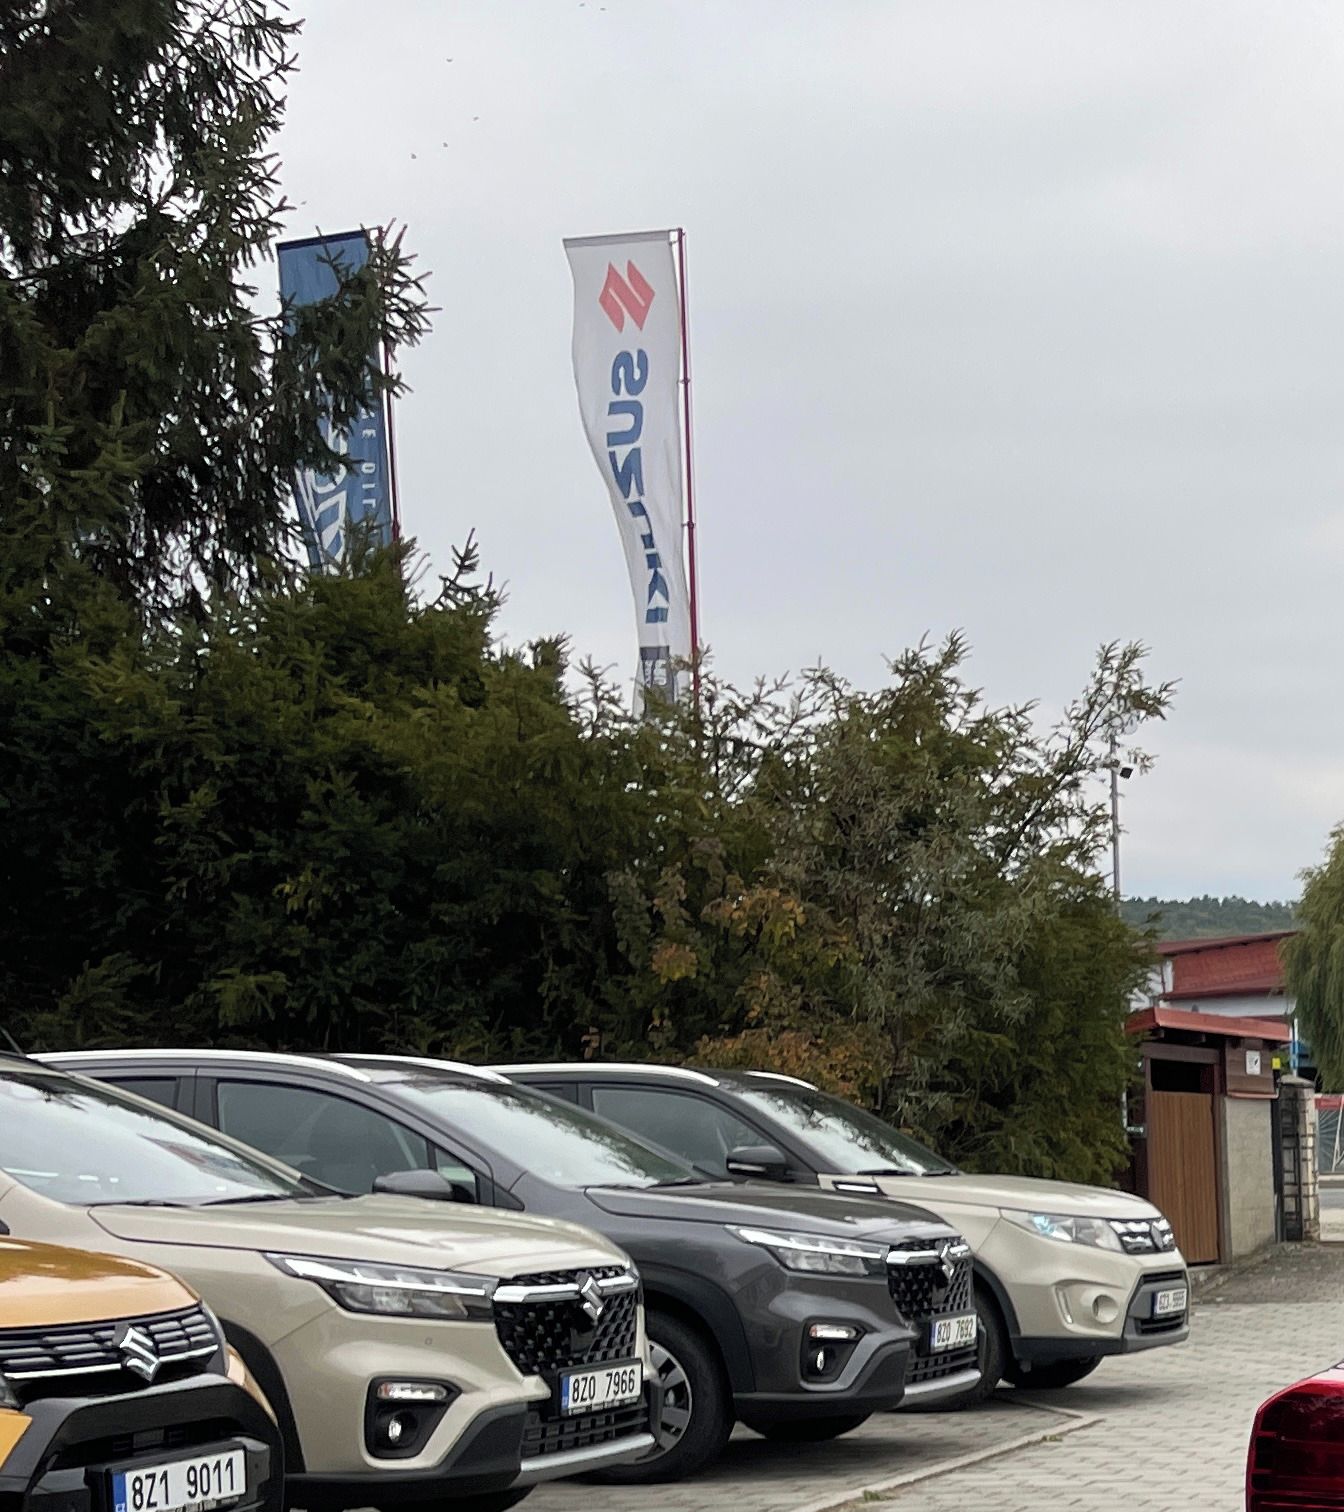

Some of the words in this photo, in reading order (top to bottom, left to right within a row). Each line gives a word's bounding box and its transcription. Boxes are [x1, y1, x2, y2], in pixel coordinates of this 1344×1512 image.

[572, 1375, 596, 1403] 8Z0
[605, 1368, 635, 1398] 7966
[132, 1469, 169, 1512] 8Z1
[187, 1456, 235, 1499] 9011
